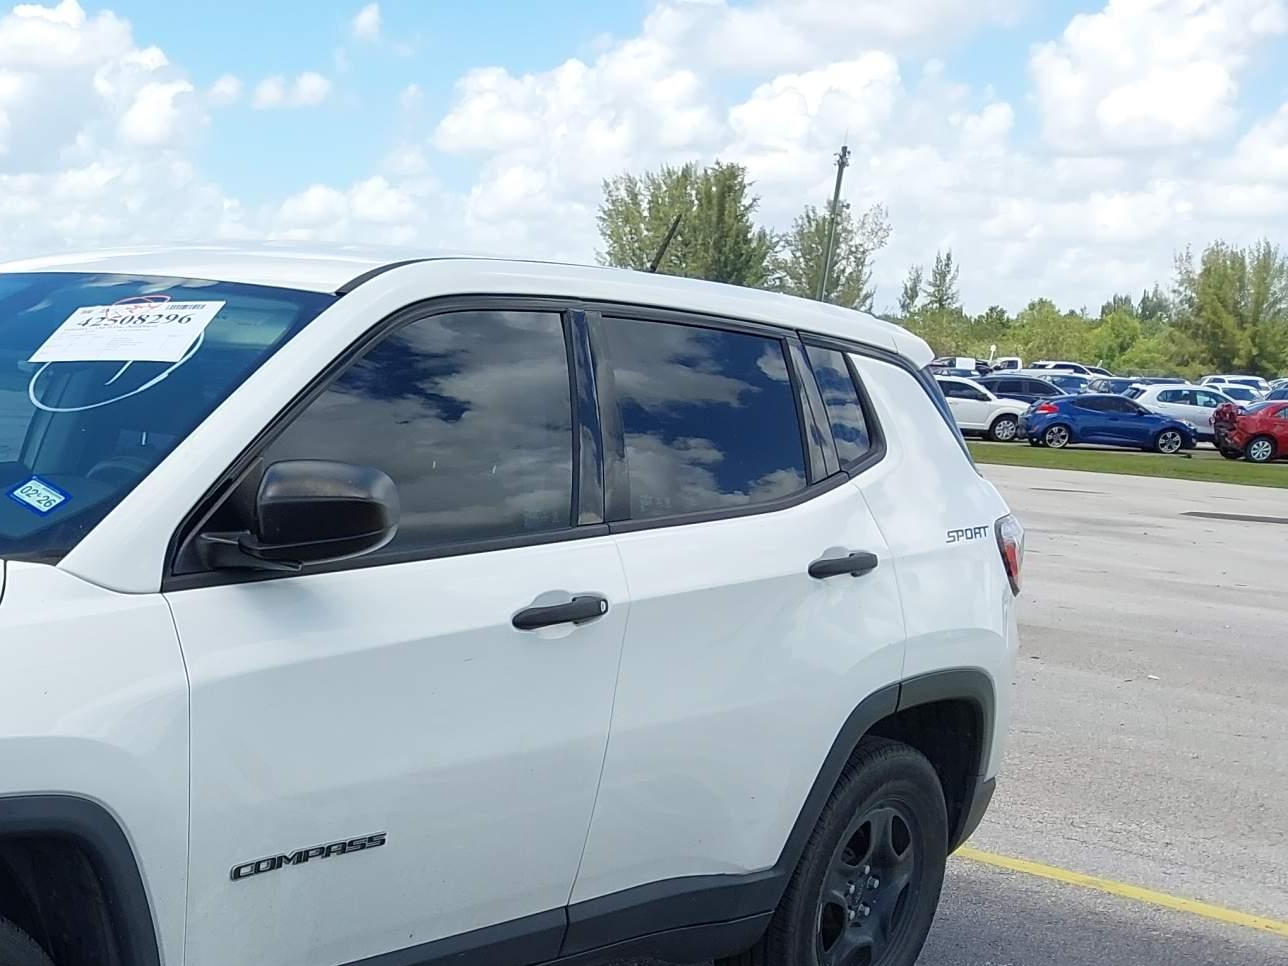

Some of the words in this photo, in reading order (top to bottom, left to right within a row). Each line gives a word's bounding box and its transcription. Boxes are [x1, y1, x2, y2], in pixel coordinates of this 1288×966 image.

[78, 312, 193, 328] 42508296
[946, 525, 989, 543] SPORT
[230, 832, 387, 880] COMPASS
